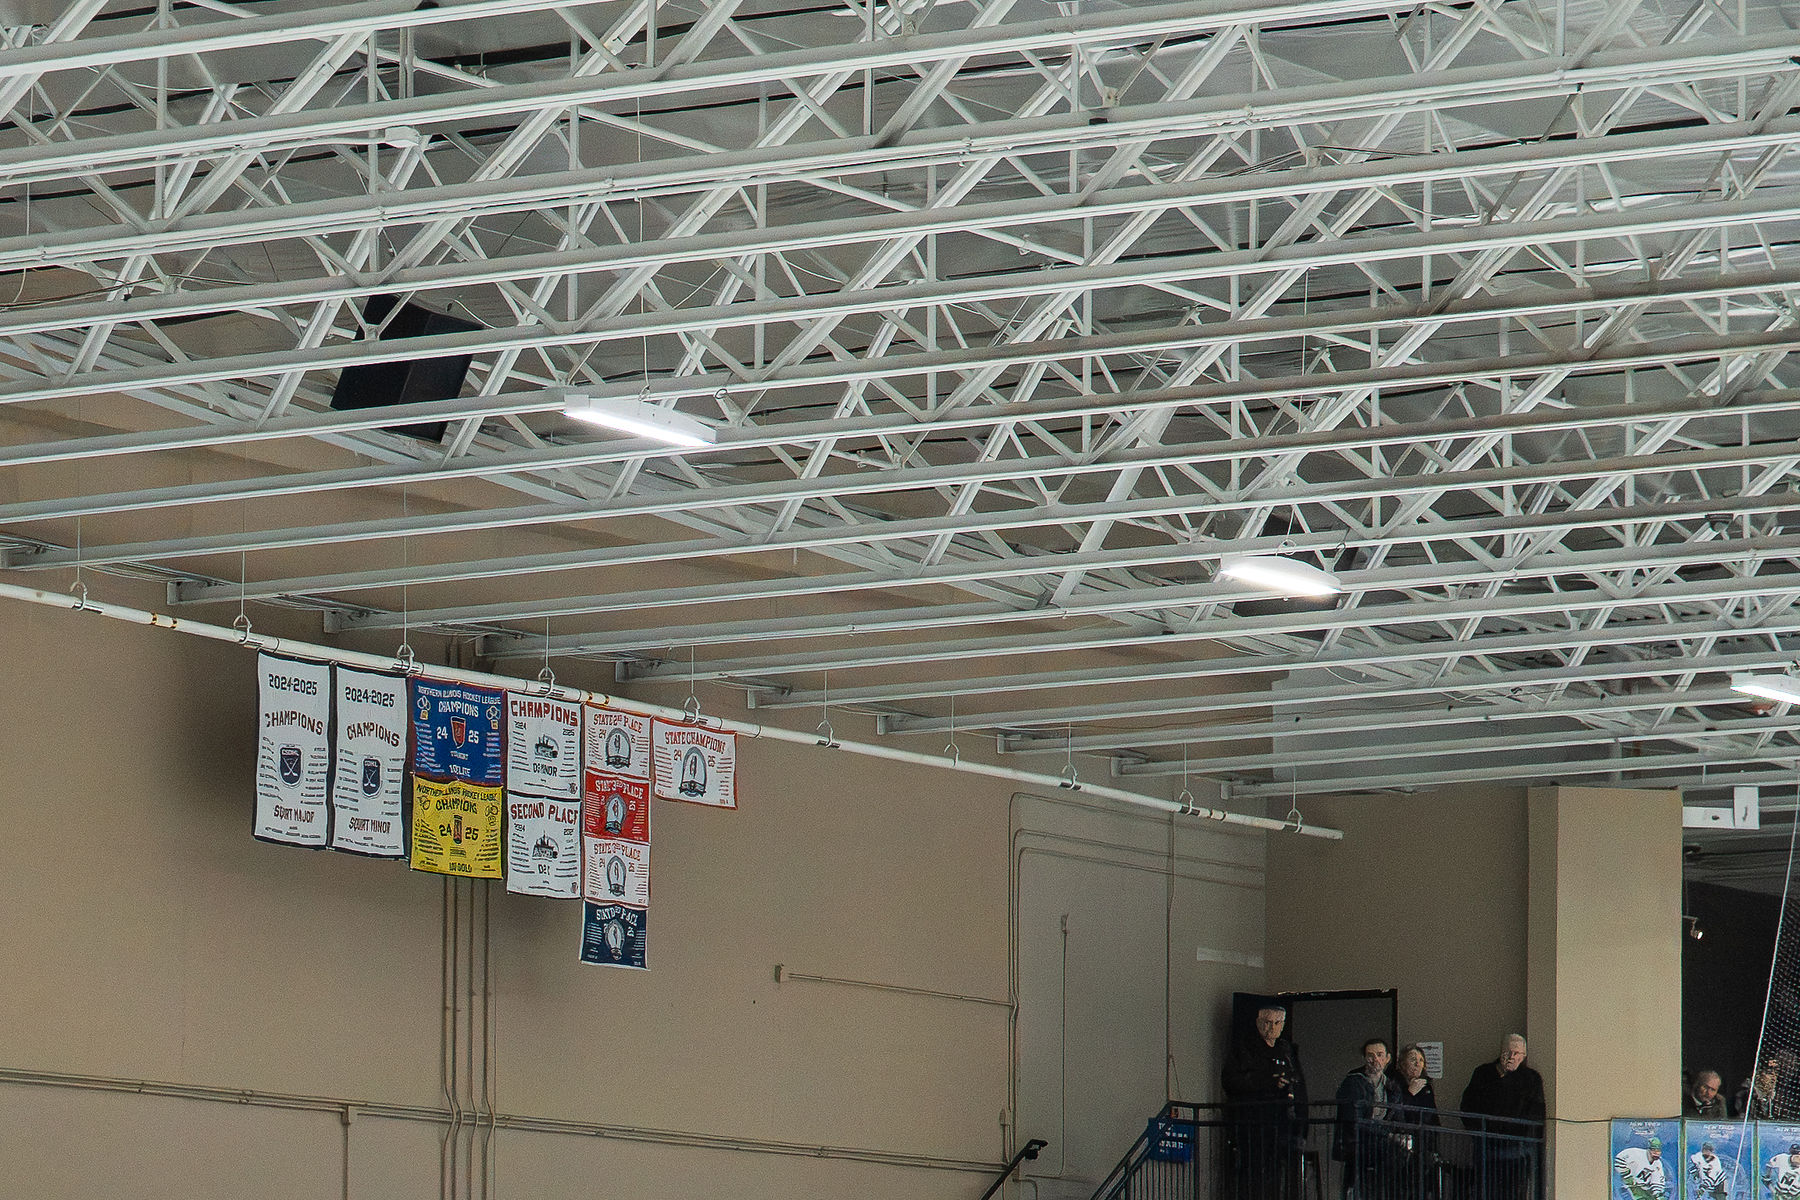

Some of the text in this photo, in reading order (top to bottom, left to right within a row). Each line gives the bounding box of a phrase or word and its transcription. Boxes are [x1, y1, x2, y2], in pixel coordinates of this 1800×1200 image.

[268, 673, 318, 696] 2024-2025
[345, 686, 395, 708] 2024-2025
[438, 701, 479, 718] CHAMPIONS
[511, 701, 578, 726] CHAMPIONS
[347, 721, 400, 748] CHAMPIONS
[436, 726, 479, 744] 24 25
[665, 731, 686, 745] STATE
[511, 802, 545, 820] SECOND
[464, 827, 479, 840] 25
